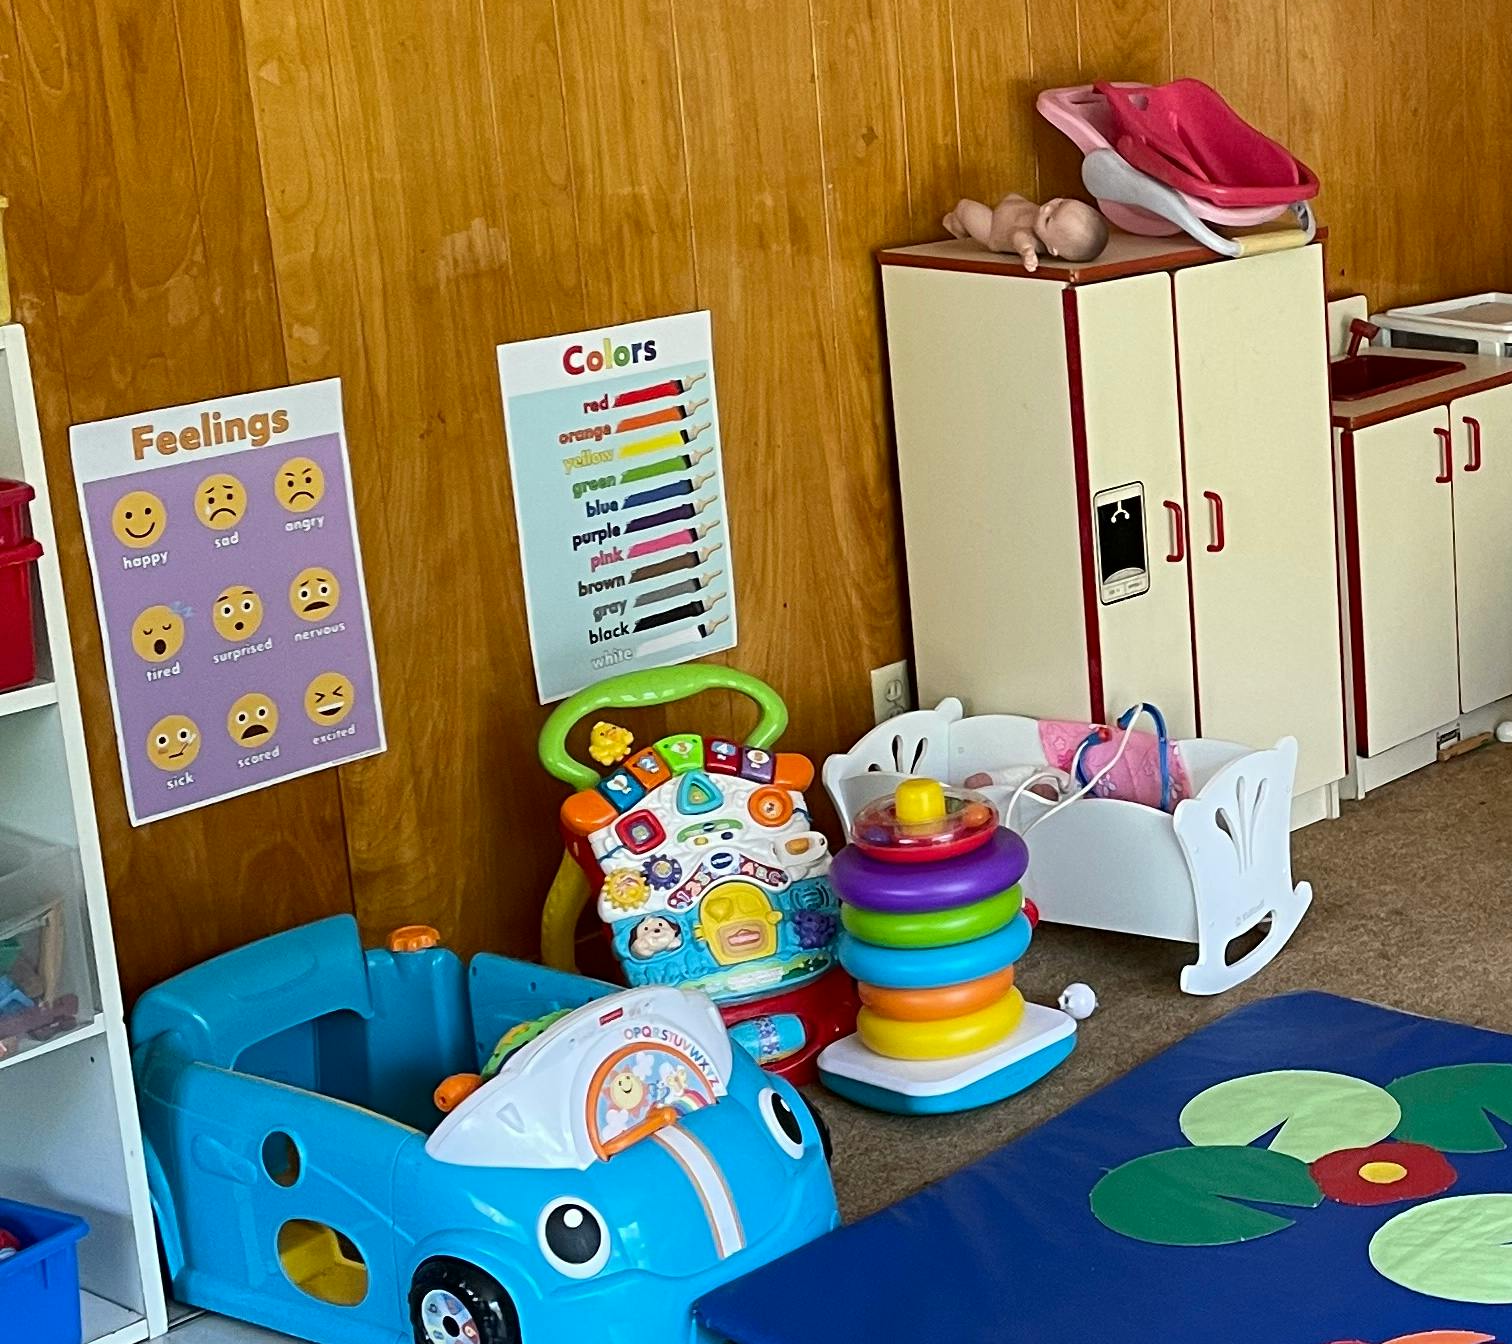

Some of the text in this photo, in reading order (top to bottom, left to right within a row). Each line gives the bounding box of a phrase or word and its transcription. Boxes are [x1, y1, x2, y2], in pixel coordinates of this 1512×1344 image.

[562, 338, 657, 375] Colors
[583, 394, 609, 414] red
[131, 409, 290, 461] Feelings
[559, 424, 612, 445] orange
[562, 449, 614, 475] yellow
[572, 475, 617, 499] green
[586, 499, 619, 518] blue
[284, 515, 325, 532] angry
[214, 532, 240, 549] sad
[572, 522, 621, 551] purple
[122, 551, 169, 571] happy
[590, 546, 625, 572] pink
[578, 574, 625, 597] brown
[592, 599, 628, 622] gray
[294, 622, 346, 643] nervous
[588, 621, 630, 645] black
[212, 638, 274, 665] surprised
[591, 648, 634, 671] white
[146, 662, 181, 682] tired
[312, 723, 357, 746] excited
[237, 745, 281, 769] scared
[166, 772, 195, 790] sick
